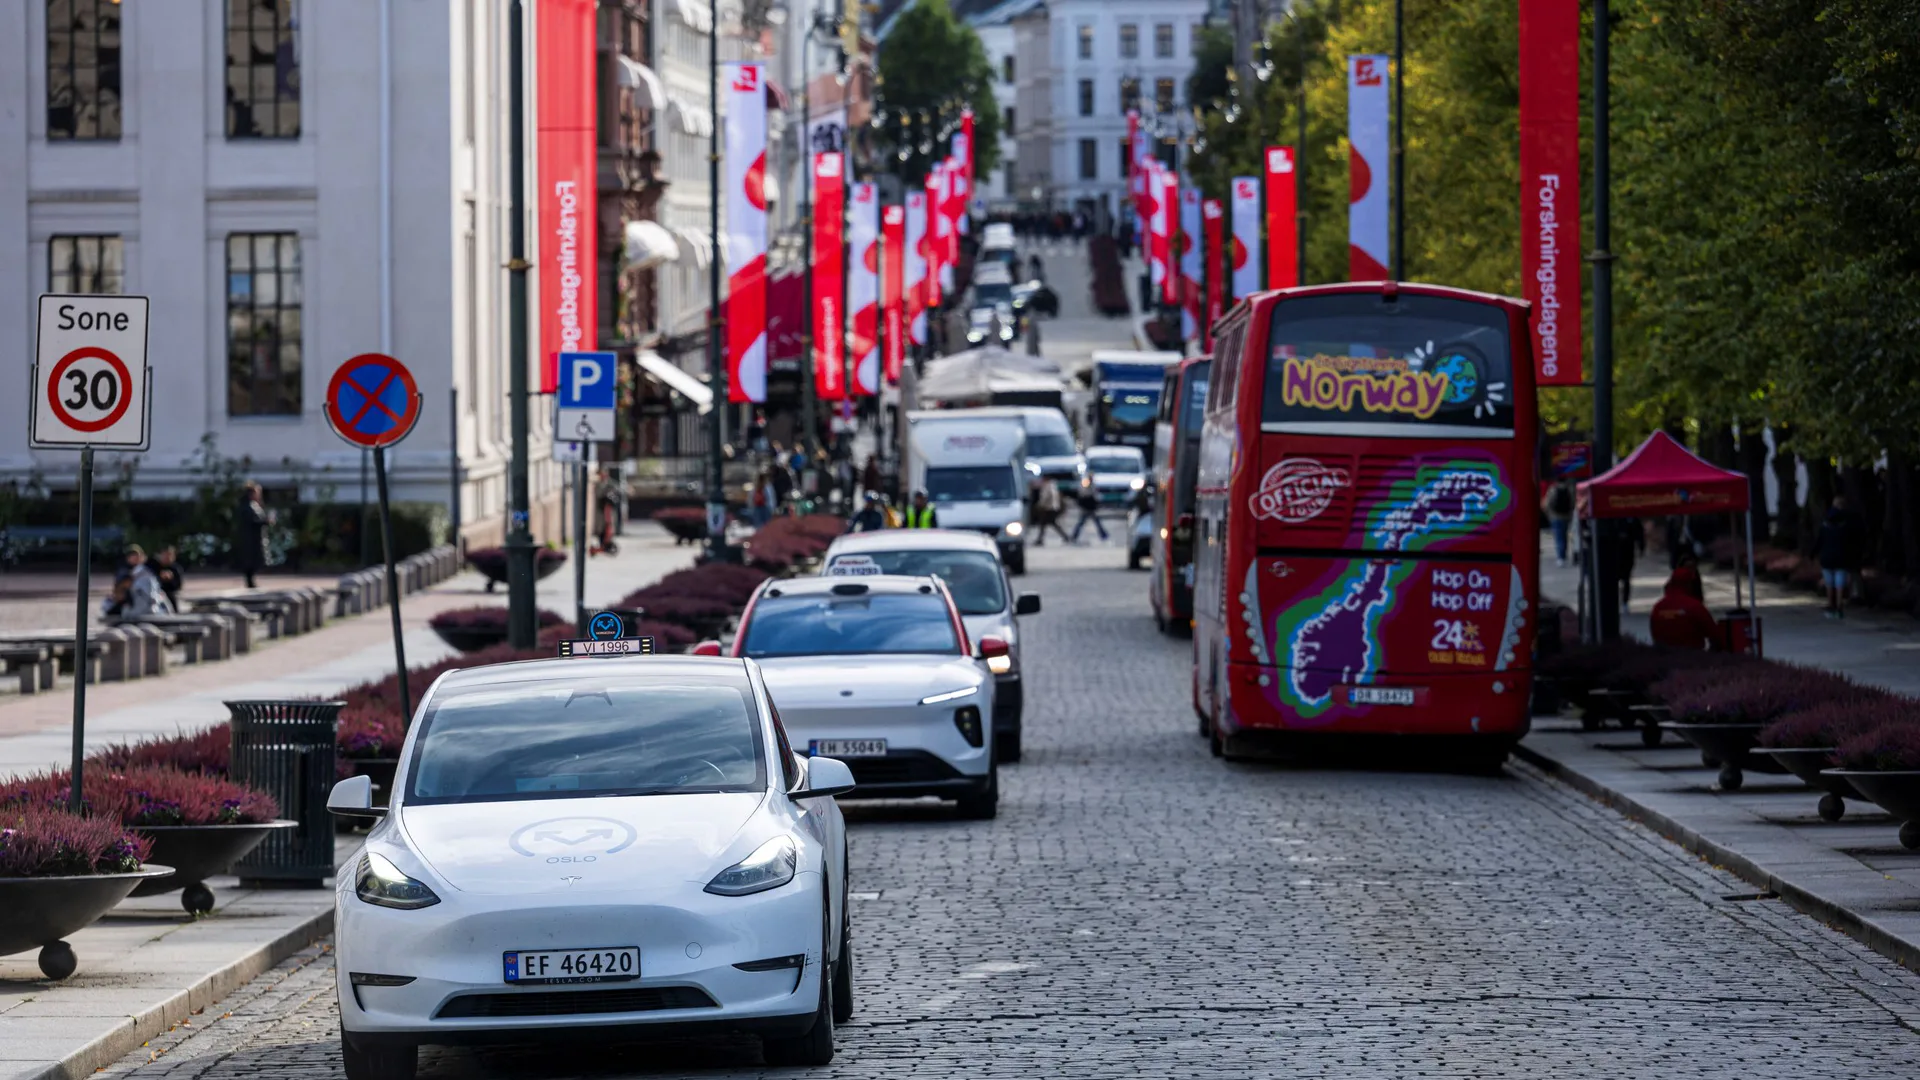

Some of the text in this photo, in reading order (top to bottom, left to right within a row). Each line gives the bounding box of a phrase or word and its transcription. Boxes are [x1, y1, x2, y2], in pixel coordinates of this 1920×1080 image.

[1537, 174, 1560, 377] Forskningsdagene
[57, 304, 129, 331] Sone
[64, 369, 117, 410] 30
[572, 359, 602, 402] P
[1284, 358, 1448, 418] Norway
[1260, 472, 1352, 511] OFFICIAL
[1432, 569, 1491, 590] Hop On
[1431, 591, 1494, 611] Hop Off
[583, 641, 630, 653] VI 1996
[1431, 619, 1463, 650] 24
[820, 742, 884, 754] EH 55049
[546, 855, 597, 864] OSLO
[525, 951, 632, 976] EF 46420
